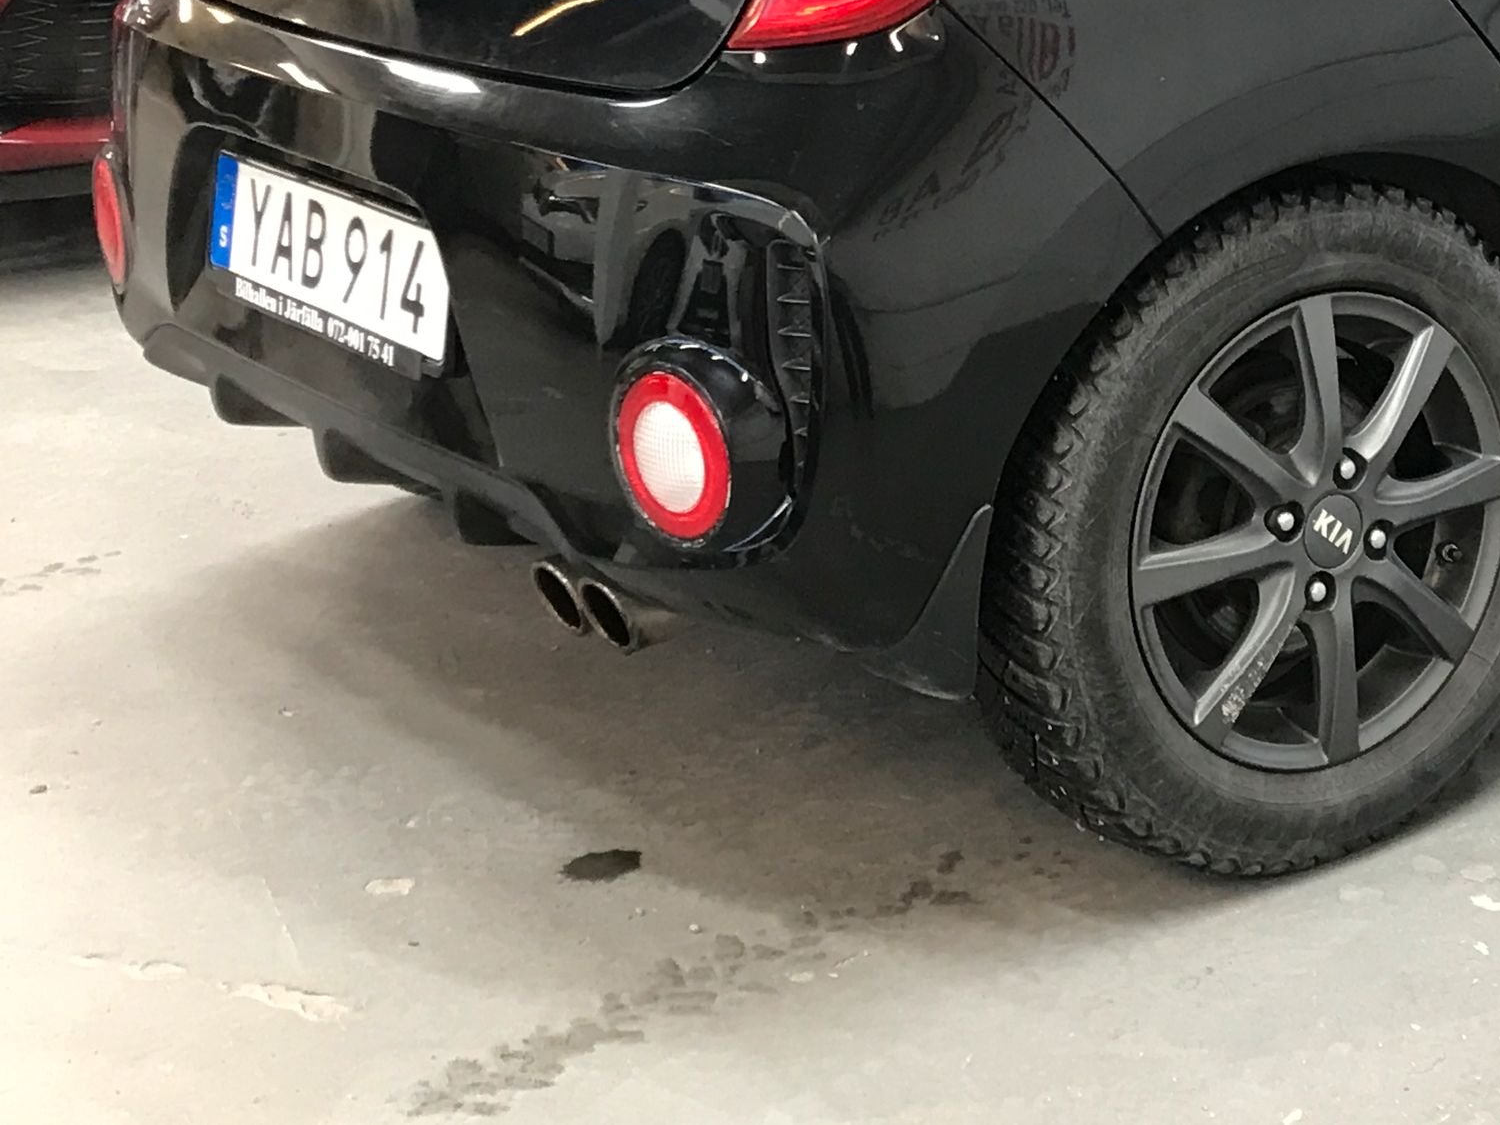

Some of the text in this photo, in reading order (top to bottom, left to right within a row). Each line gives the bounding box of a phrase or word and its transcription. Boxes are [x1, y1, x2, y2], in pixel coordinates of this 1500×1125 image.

[218, 225, 228, 248] S
[250, 177, 425, 335] YAB 914
